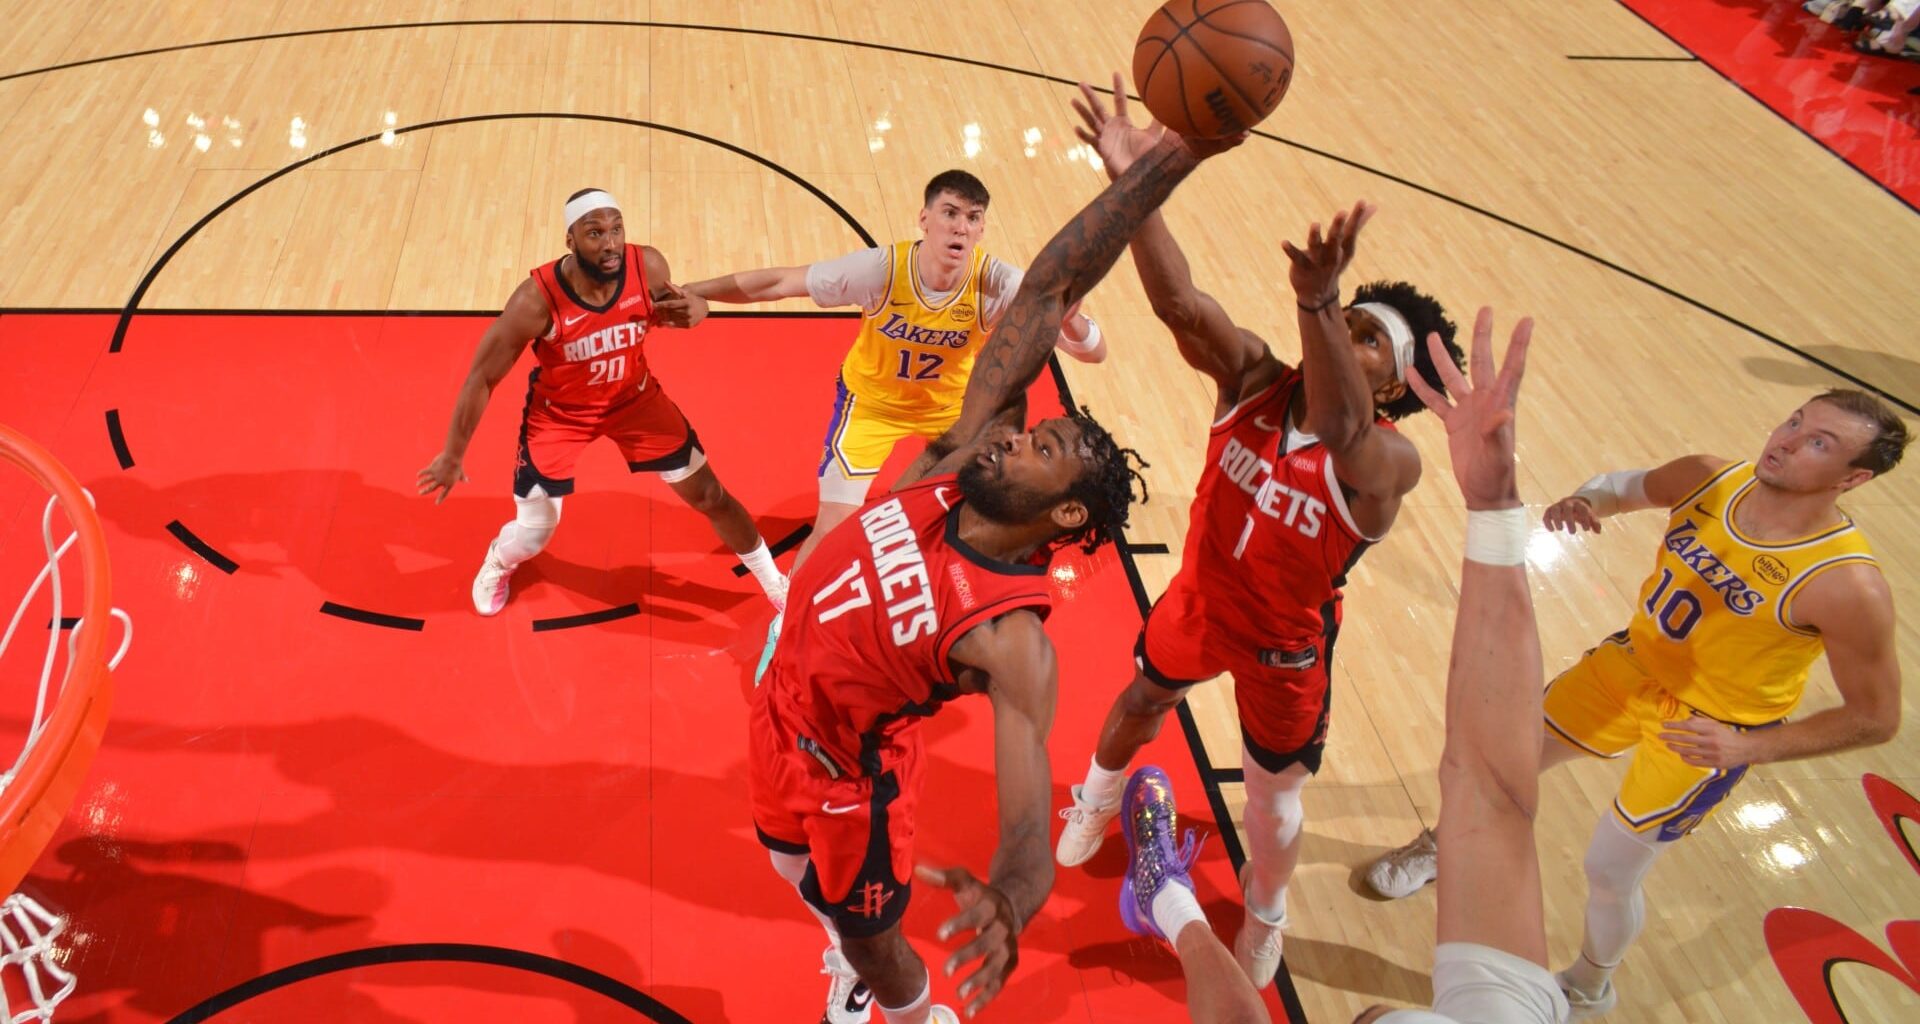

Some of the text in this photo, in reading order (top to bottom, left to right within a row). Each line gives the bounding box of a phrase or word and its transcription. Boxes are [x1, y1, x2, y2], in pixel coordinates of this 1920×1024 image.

[563, 320, 648, 362] ROCKETS
[878, 313, 971, 348] LAKERS
[587, 355, 626, 385] 20
[896, 349, 944, 380] 12
[1232, 512, 1255, 561] 1
[859, 497, 938, 647] ROCKETS
[1664, 518, 1766, 616] LAKERS
[1757, 556, 1786, 583] bibigo
[813, 559, 872, 624] 17
[1645, 568, 1703, 641] 10
